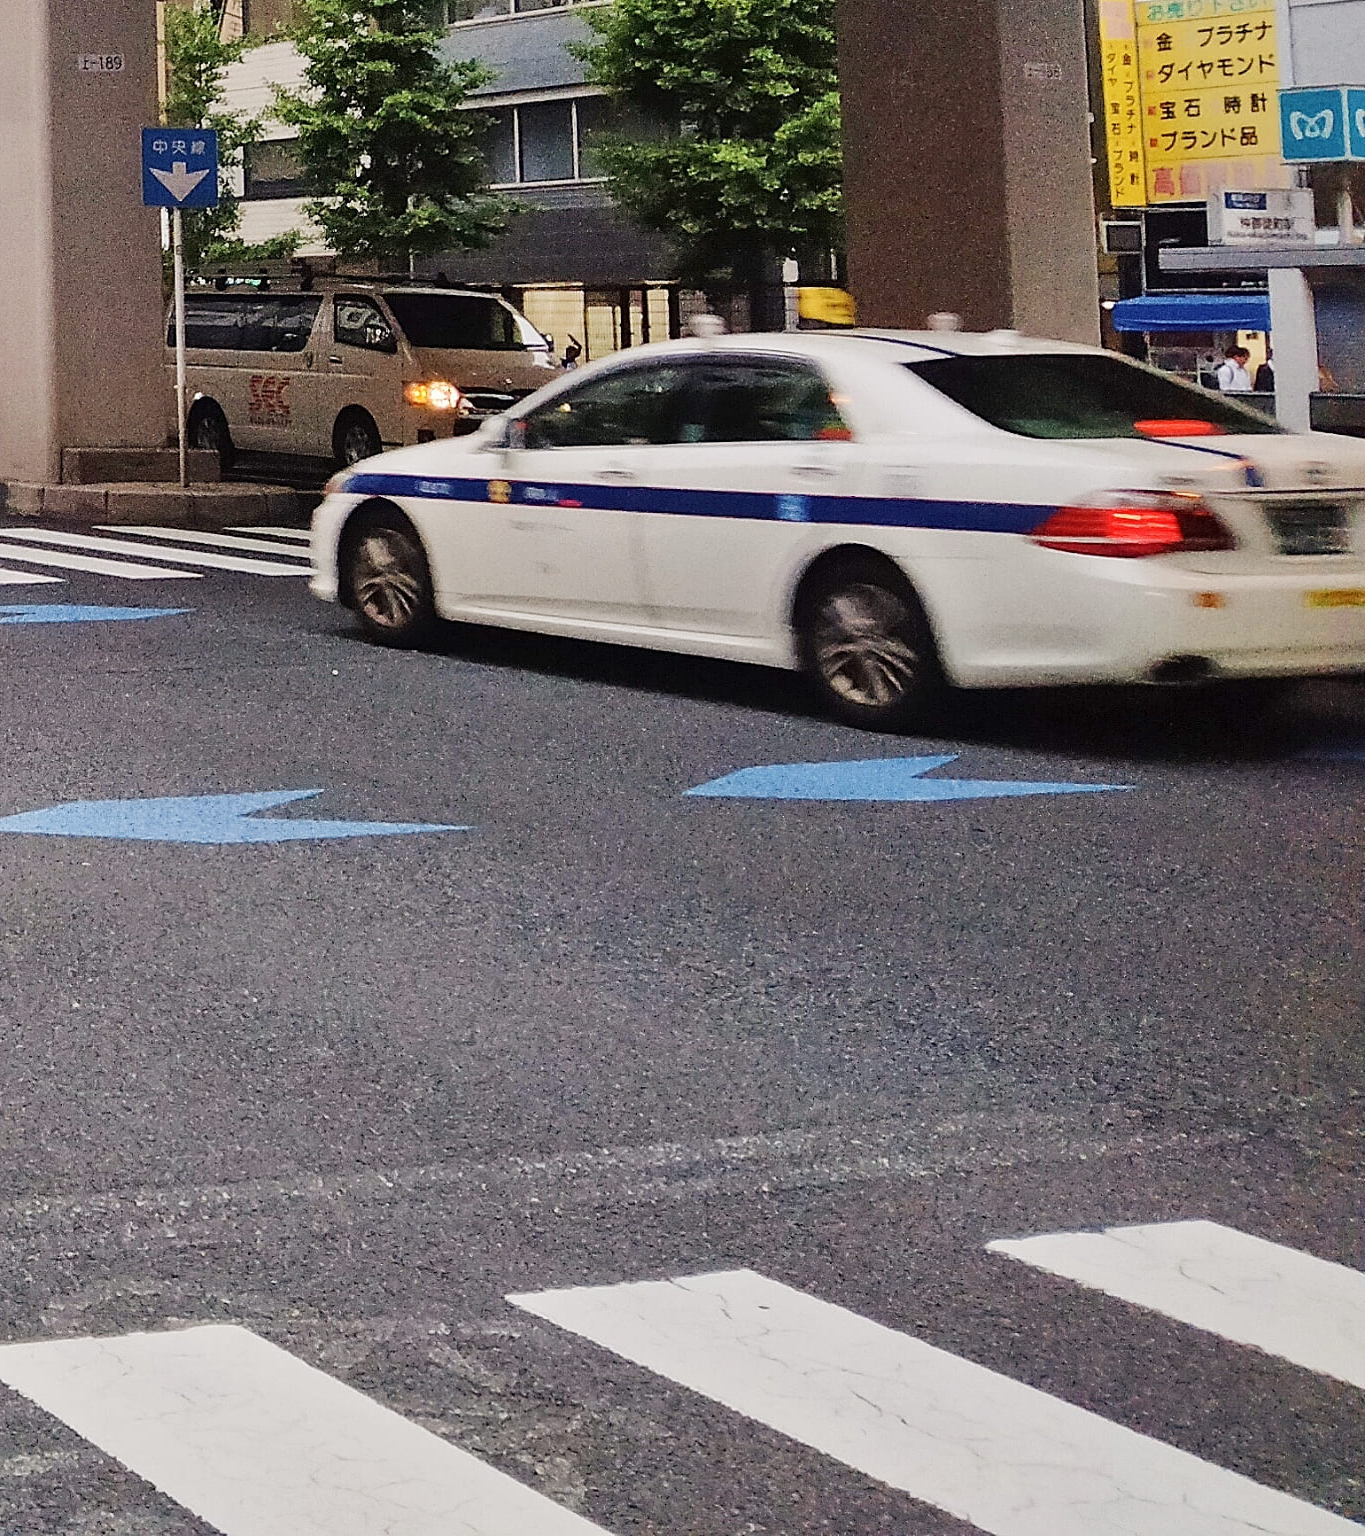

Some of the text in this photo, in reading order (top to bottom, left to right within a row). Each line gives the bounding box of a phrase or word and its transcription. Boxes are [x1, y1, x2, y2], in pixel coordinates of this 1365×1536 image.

[1156, 32, 1173, 52] 金
[1157, 54, 1275, 83] ダイヤモンド
[1159, 93, 1268, 120] 宝石 時計
[1161, 126, 1259, 152] ブランド品
